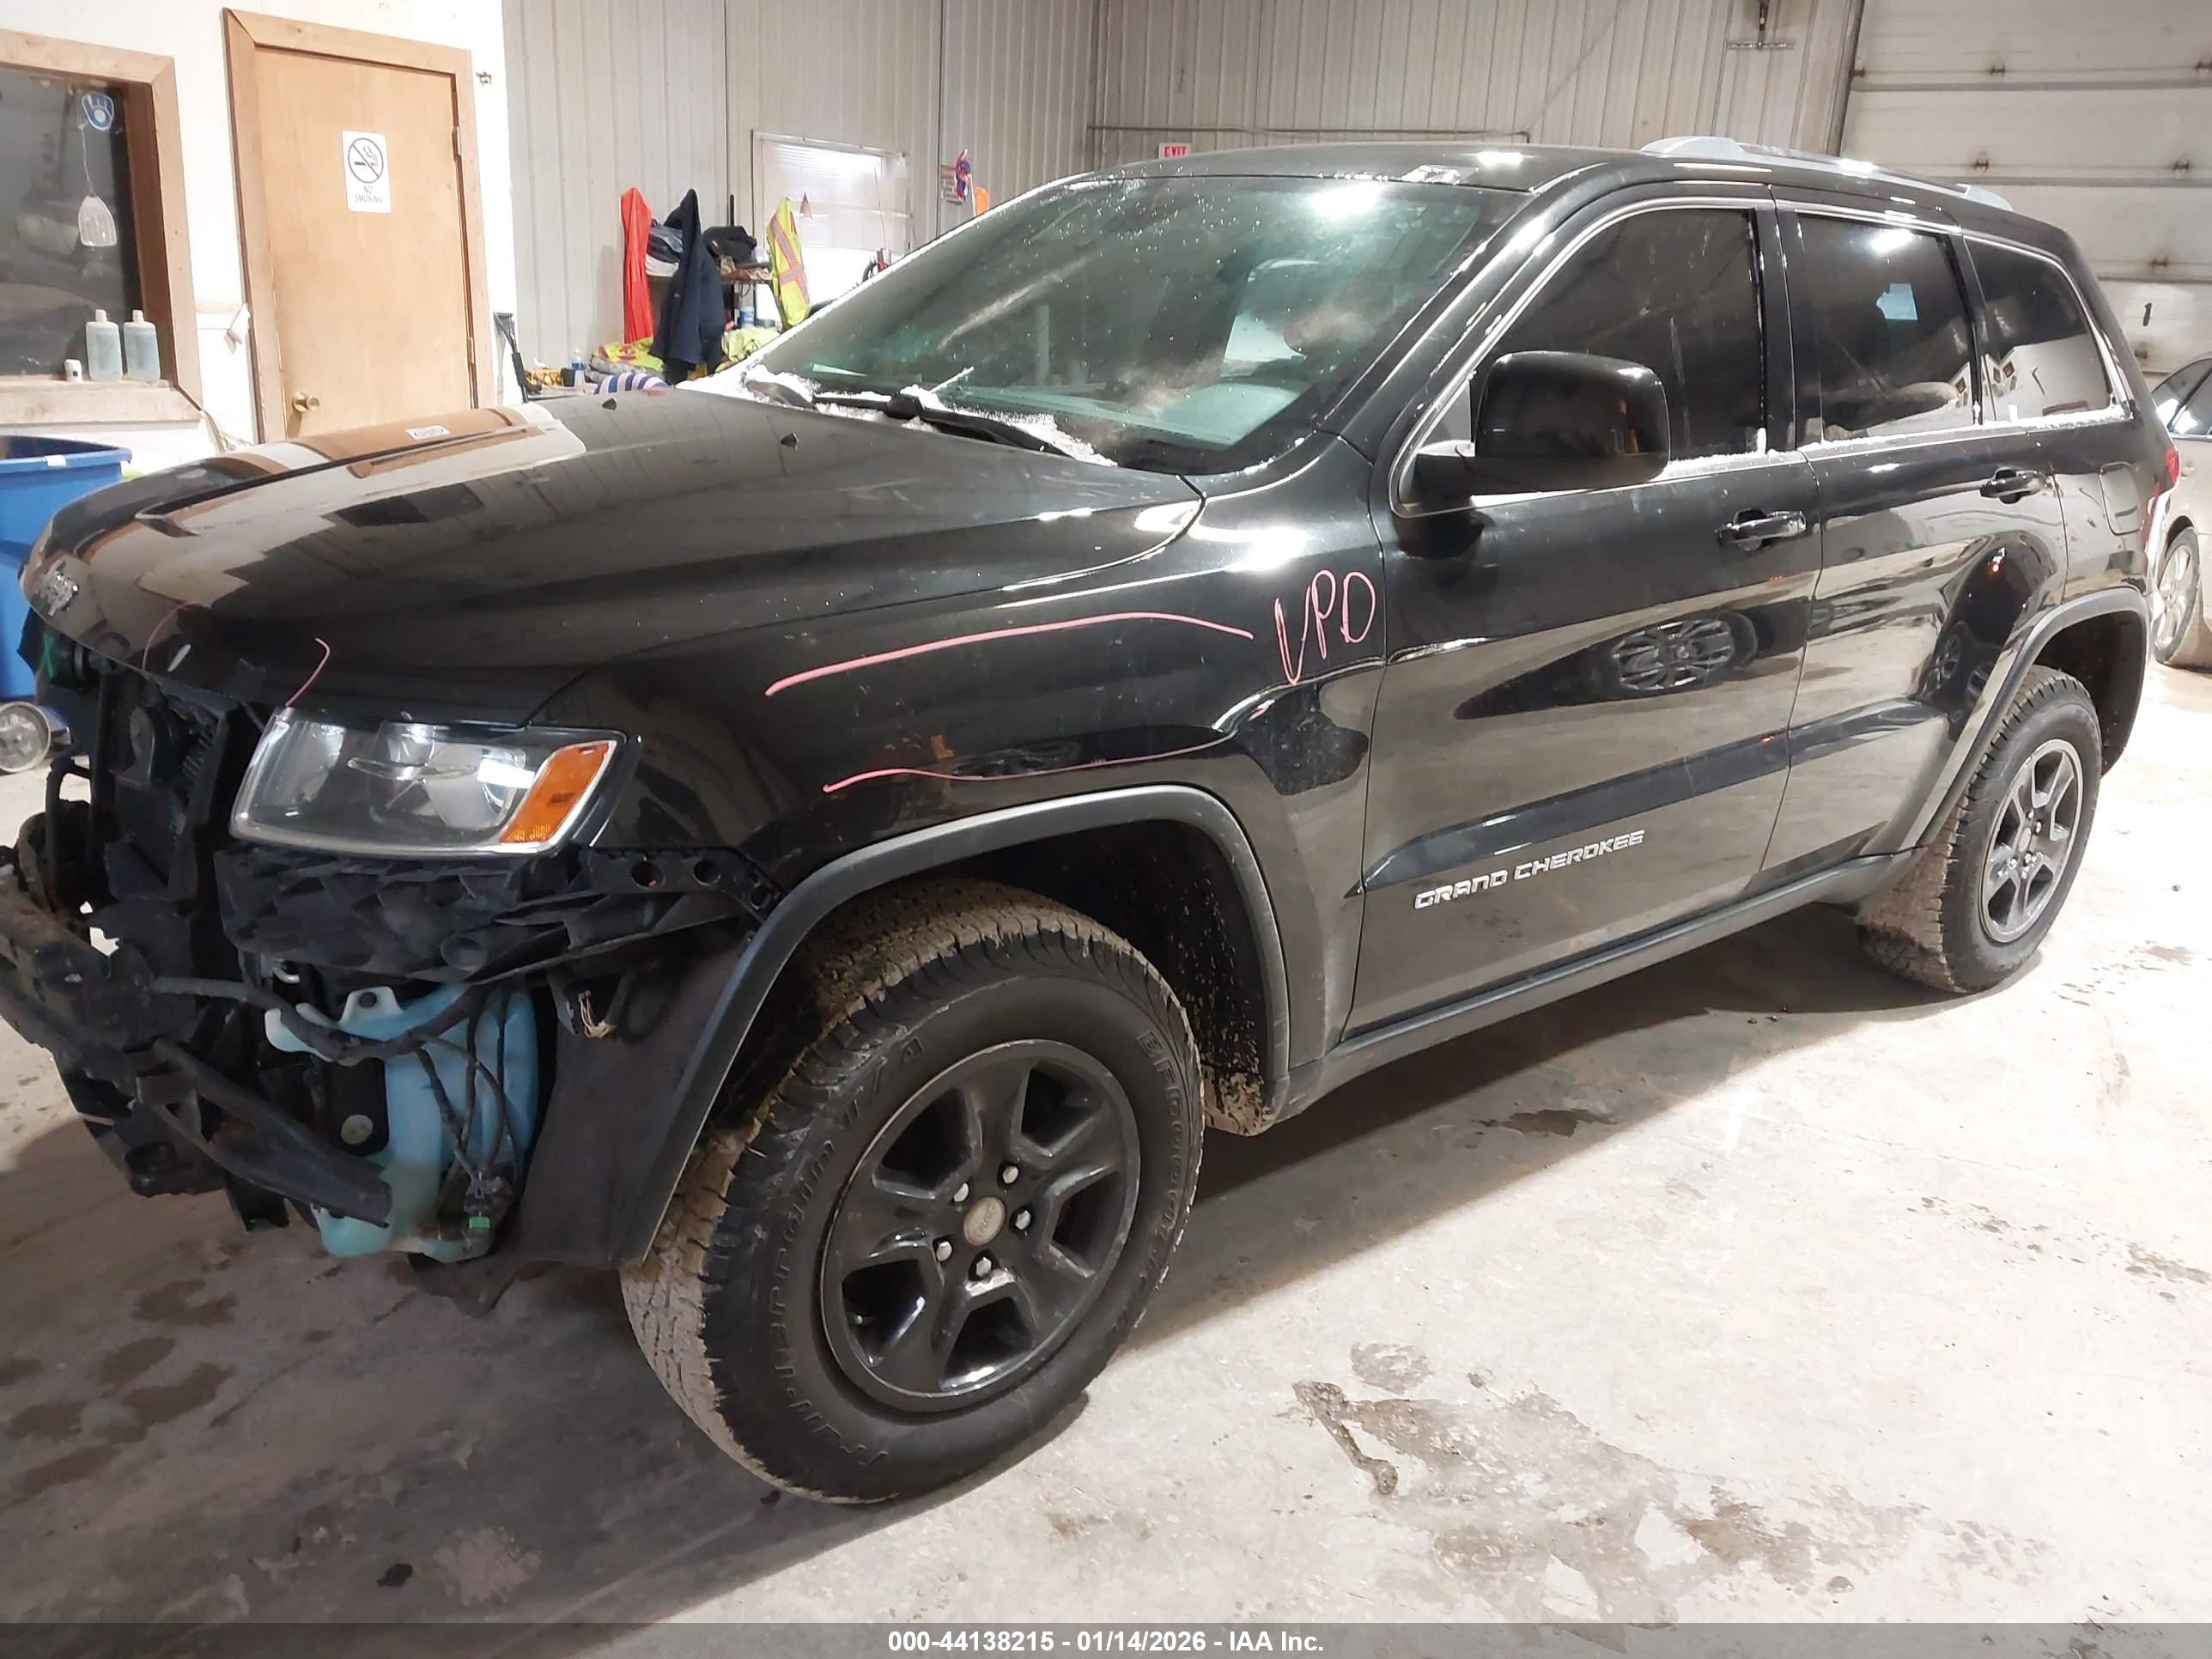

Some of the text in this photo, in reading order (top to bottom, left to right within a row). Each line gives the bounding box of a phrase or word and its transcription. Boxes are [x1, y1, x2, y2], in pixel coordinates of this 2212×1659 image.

[354, 194, 384, 204] SMOKING
[363, 185, 373, 194] NO
[2142, 302, 2153, 326] 1
[1414, 830, 1645, 909] GRAND CHEROKEE
[1136, 1030, 1183, 1283] BFGoodr
